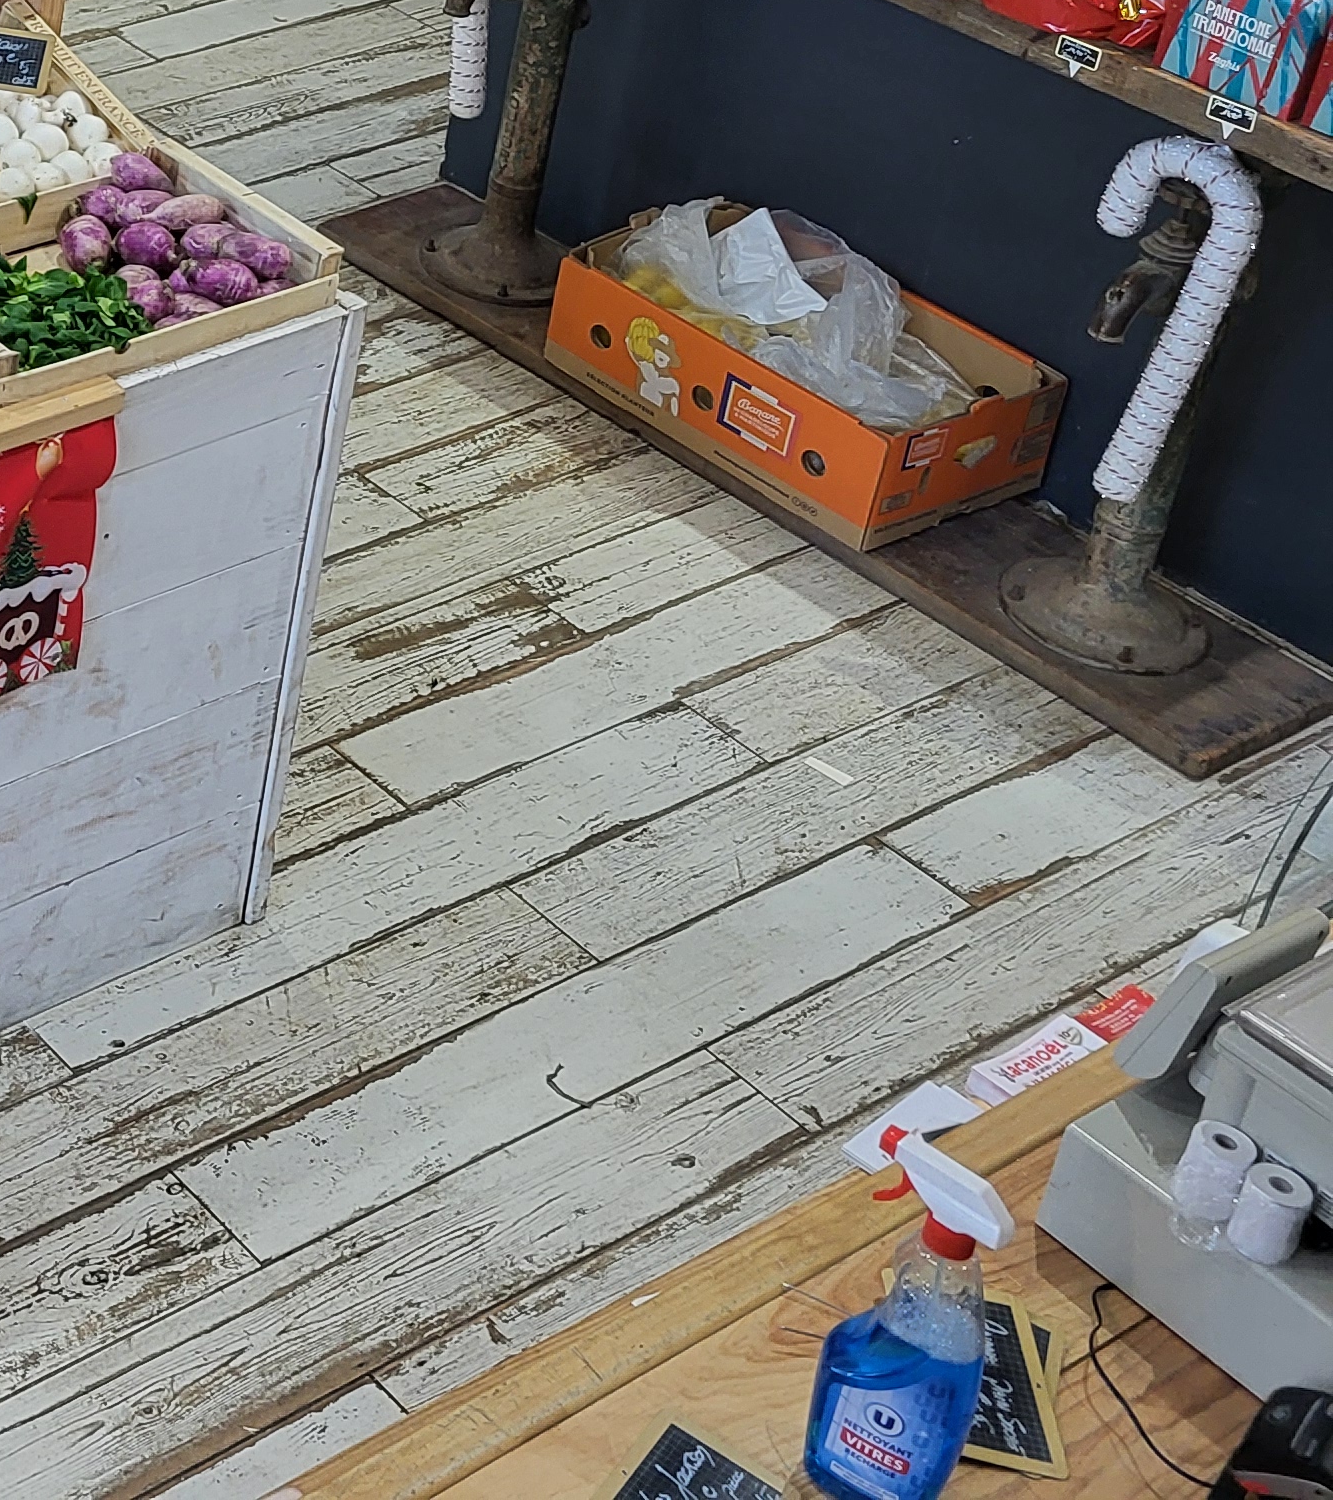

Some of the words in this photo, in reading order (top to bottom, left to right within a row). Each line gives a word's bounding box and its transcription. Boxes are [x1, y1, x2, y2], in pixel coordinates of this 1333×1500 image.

[1191, 13, 1276, 58] TRADIZIONALE
[1204, 0, 1272, 41] PANETTONE
[738, 398, 781, 425] Banane
[843, 1417, 913, 1459] NETTOYANT
[874, 1409, 895, 1430] U
[844, 1447, 896, 1479] RECHARGE
[846, 1431, 903, 1471] VITRES
